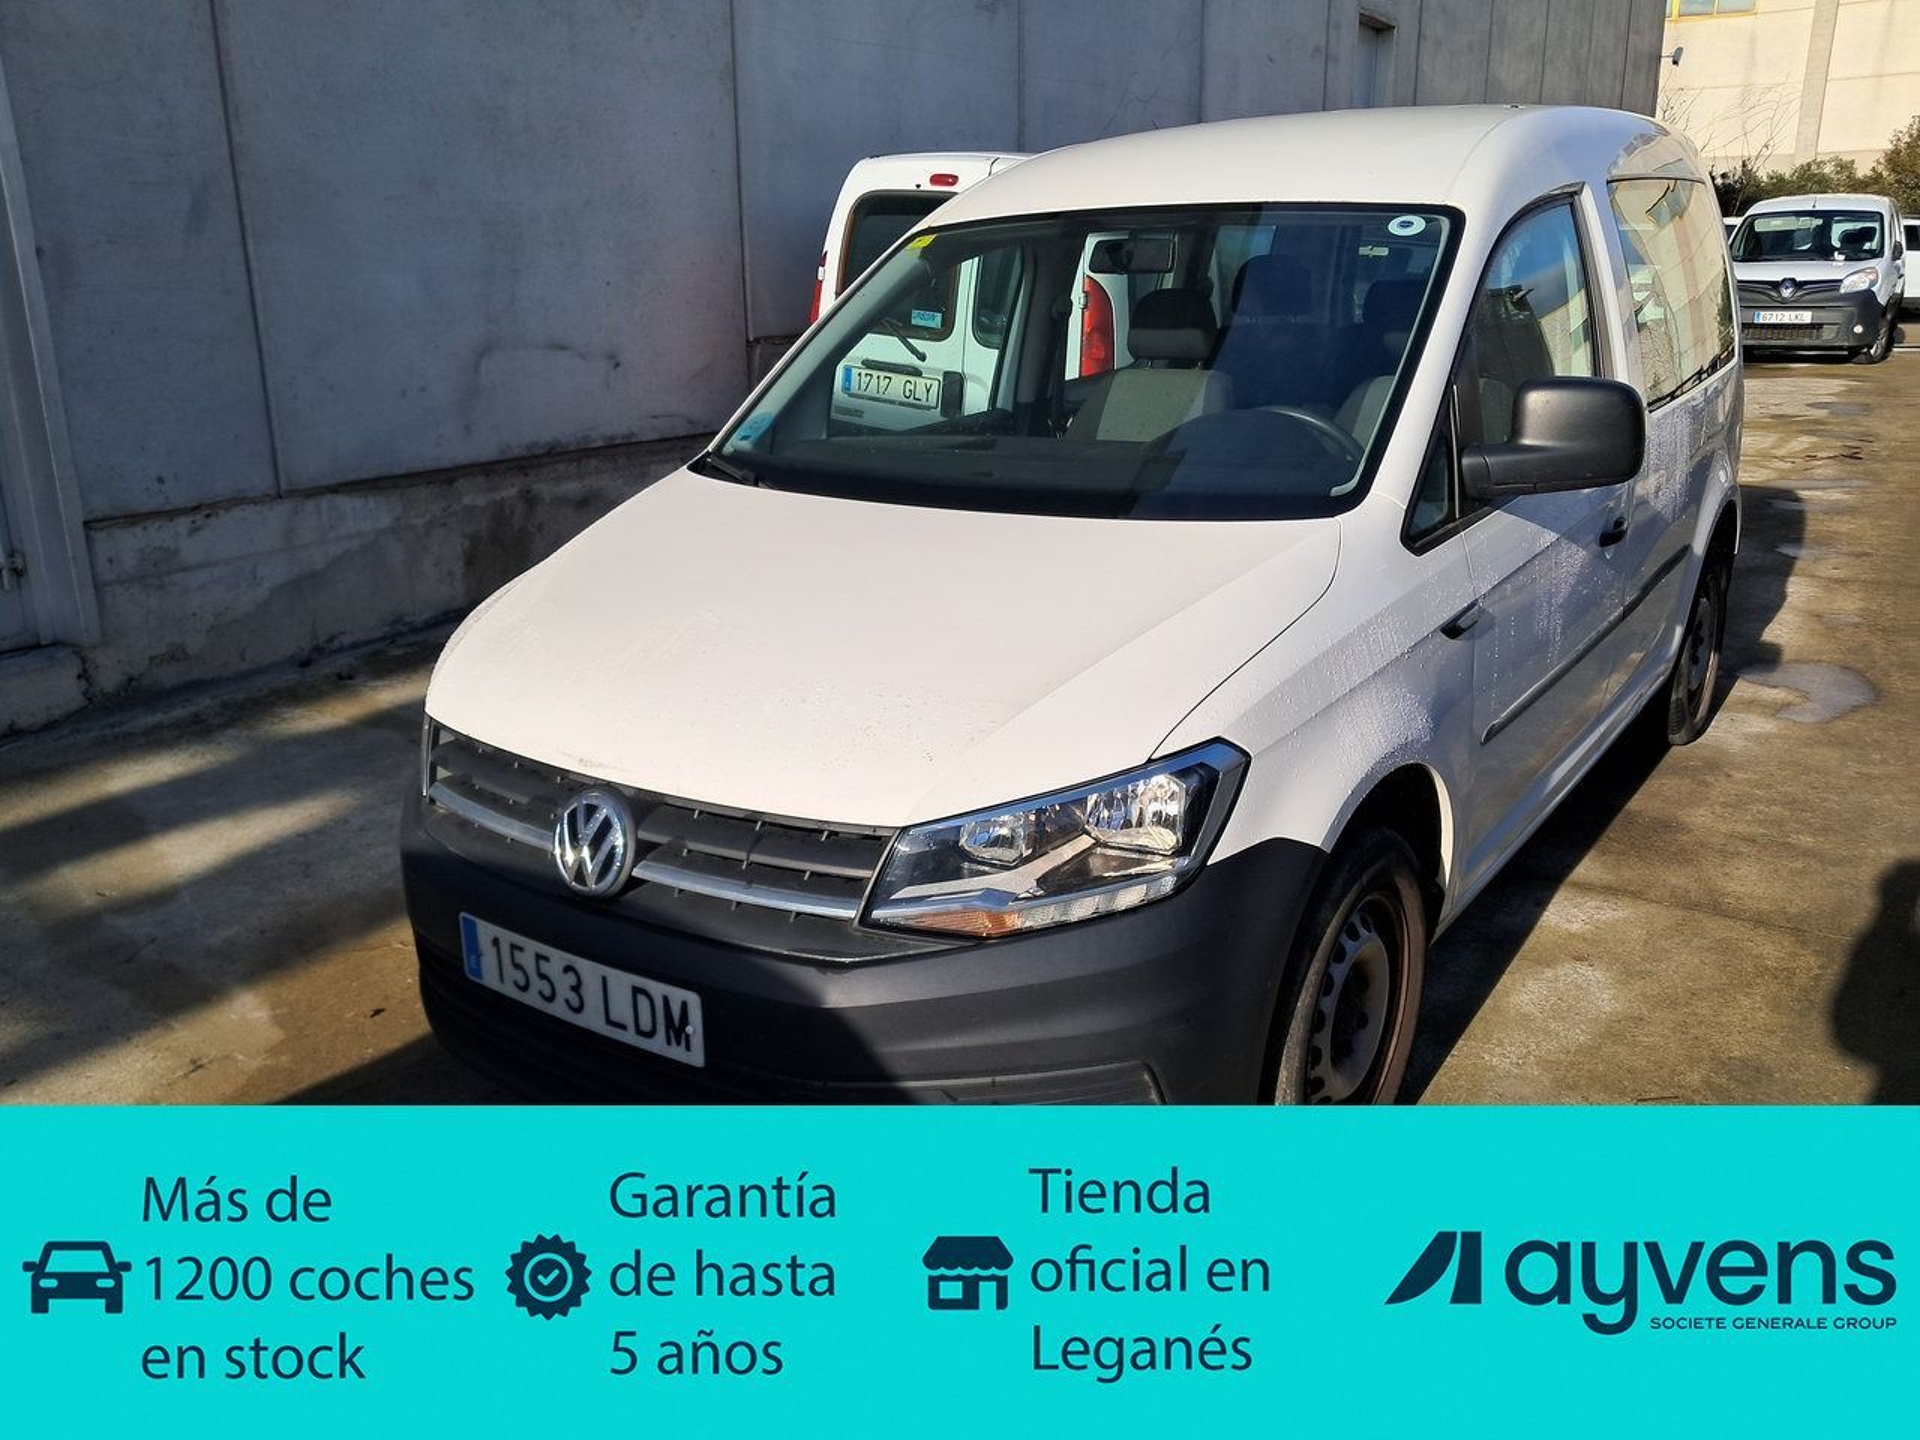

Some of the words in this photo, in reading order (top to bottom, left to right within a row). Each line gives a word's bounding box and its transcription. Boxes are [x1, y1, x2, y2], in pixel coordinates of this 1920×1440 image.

[1762, 312, 1786, 322] 6712
[856, 371, 893, 396] 1717
[902, 379, 934, 403] GLY
[491, 936, 585, 1015] 1553
[602, 973, 692, 1052] LDM
